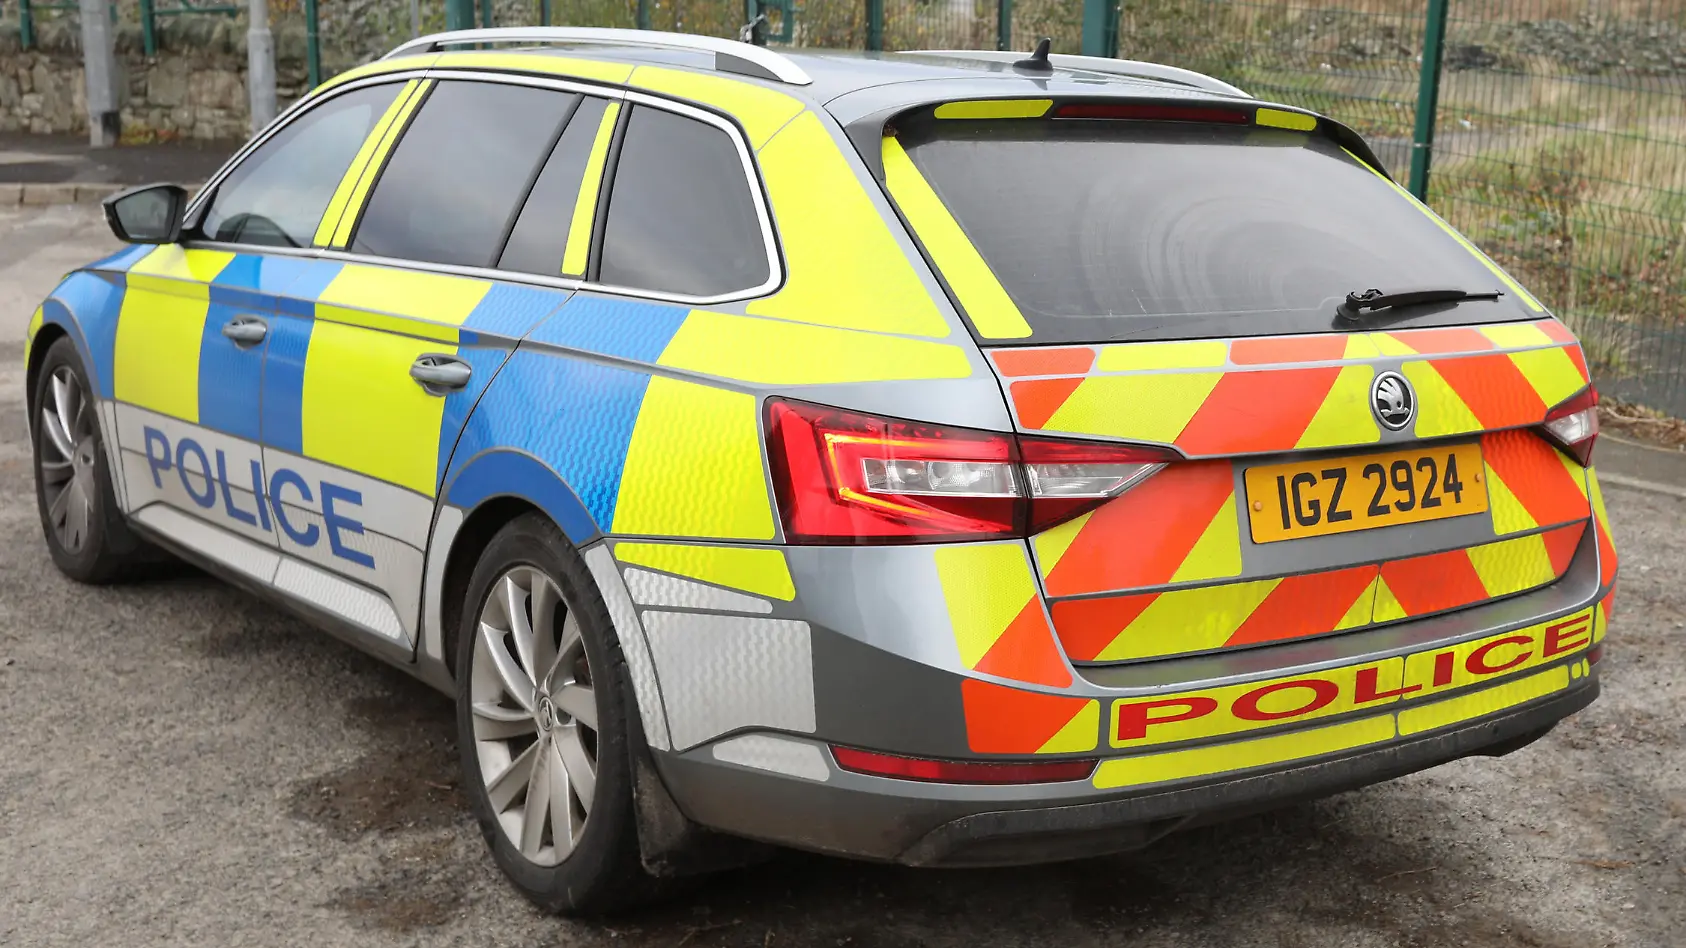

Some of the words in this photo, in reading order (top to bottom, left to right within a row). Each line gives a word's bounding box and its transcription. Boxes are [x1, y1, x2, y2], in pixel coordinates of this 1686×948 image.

[144, 425, 376, 570] POLICE
[1276, 467, 1353, 530] IGZ
[1362, 453, 1463, 517] 2924
[1117, 614, 1591, 741] POLICE
